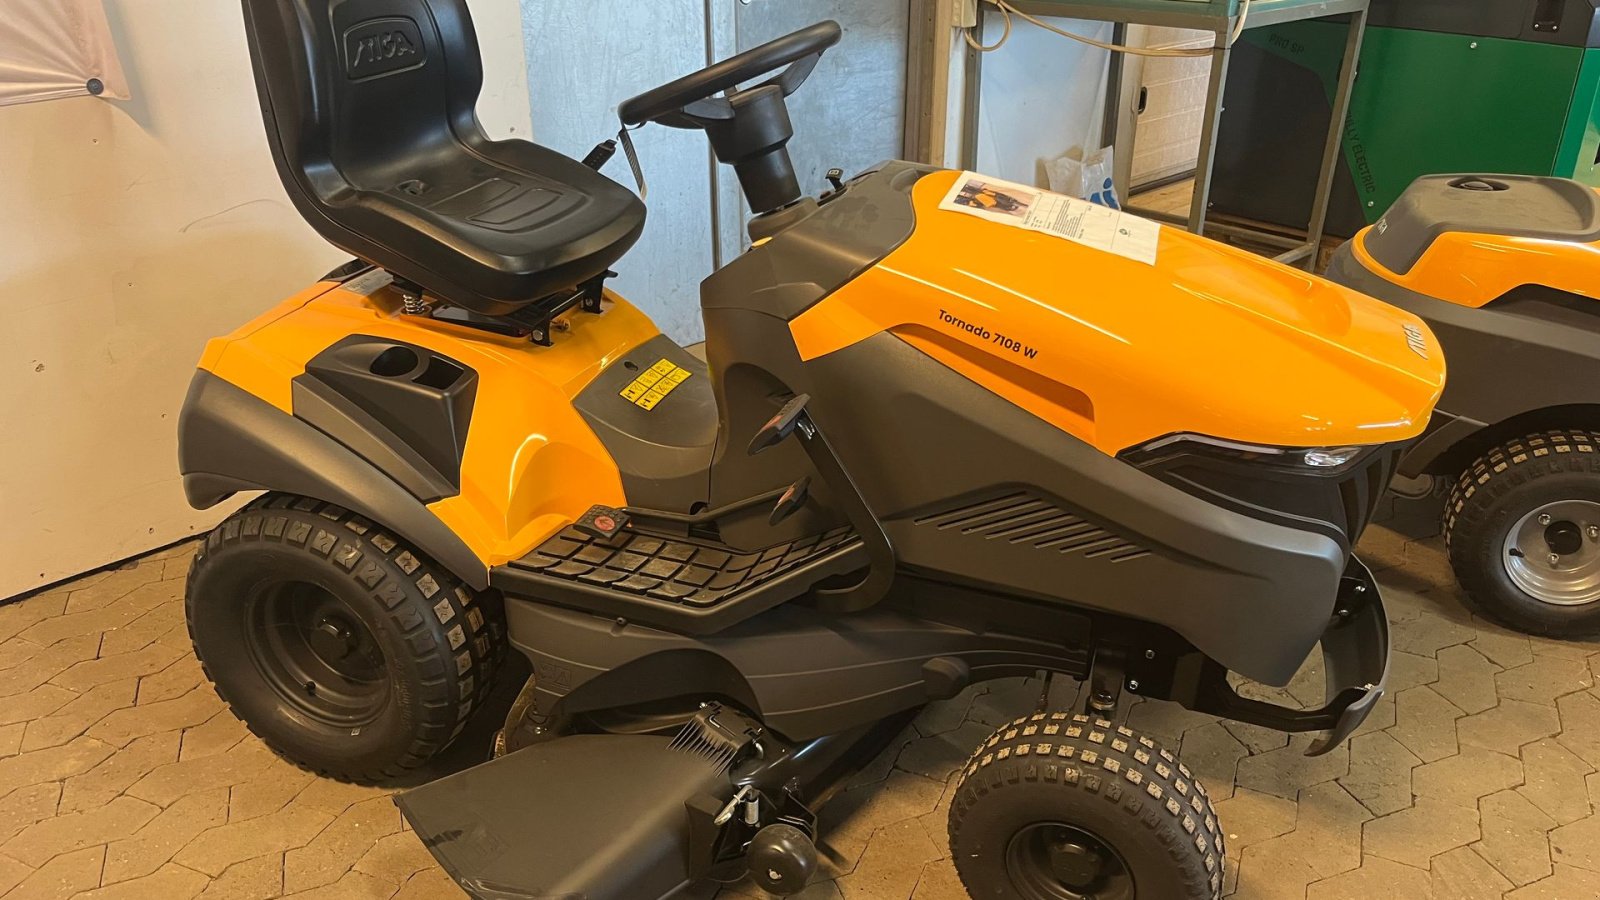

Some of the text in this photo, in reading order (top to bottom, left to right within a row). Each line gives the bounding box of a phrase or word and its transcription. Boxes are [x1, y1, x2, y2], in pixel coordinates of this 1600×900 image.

[354, 31, 416, 67] STIGA
[1268, 33, 1290, 49] PRO
[1351, 143, 1376, 194] ELECTRIC
[938, 309, 1038, 360] Tornado 7108 W
